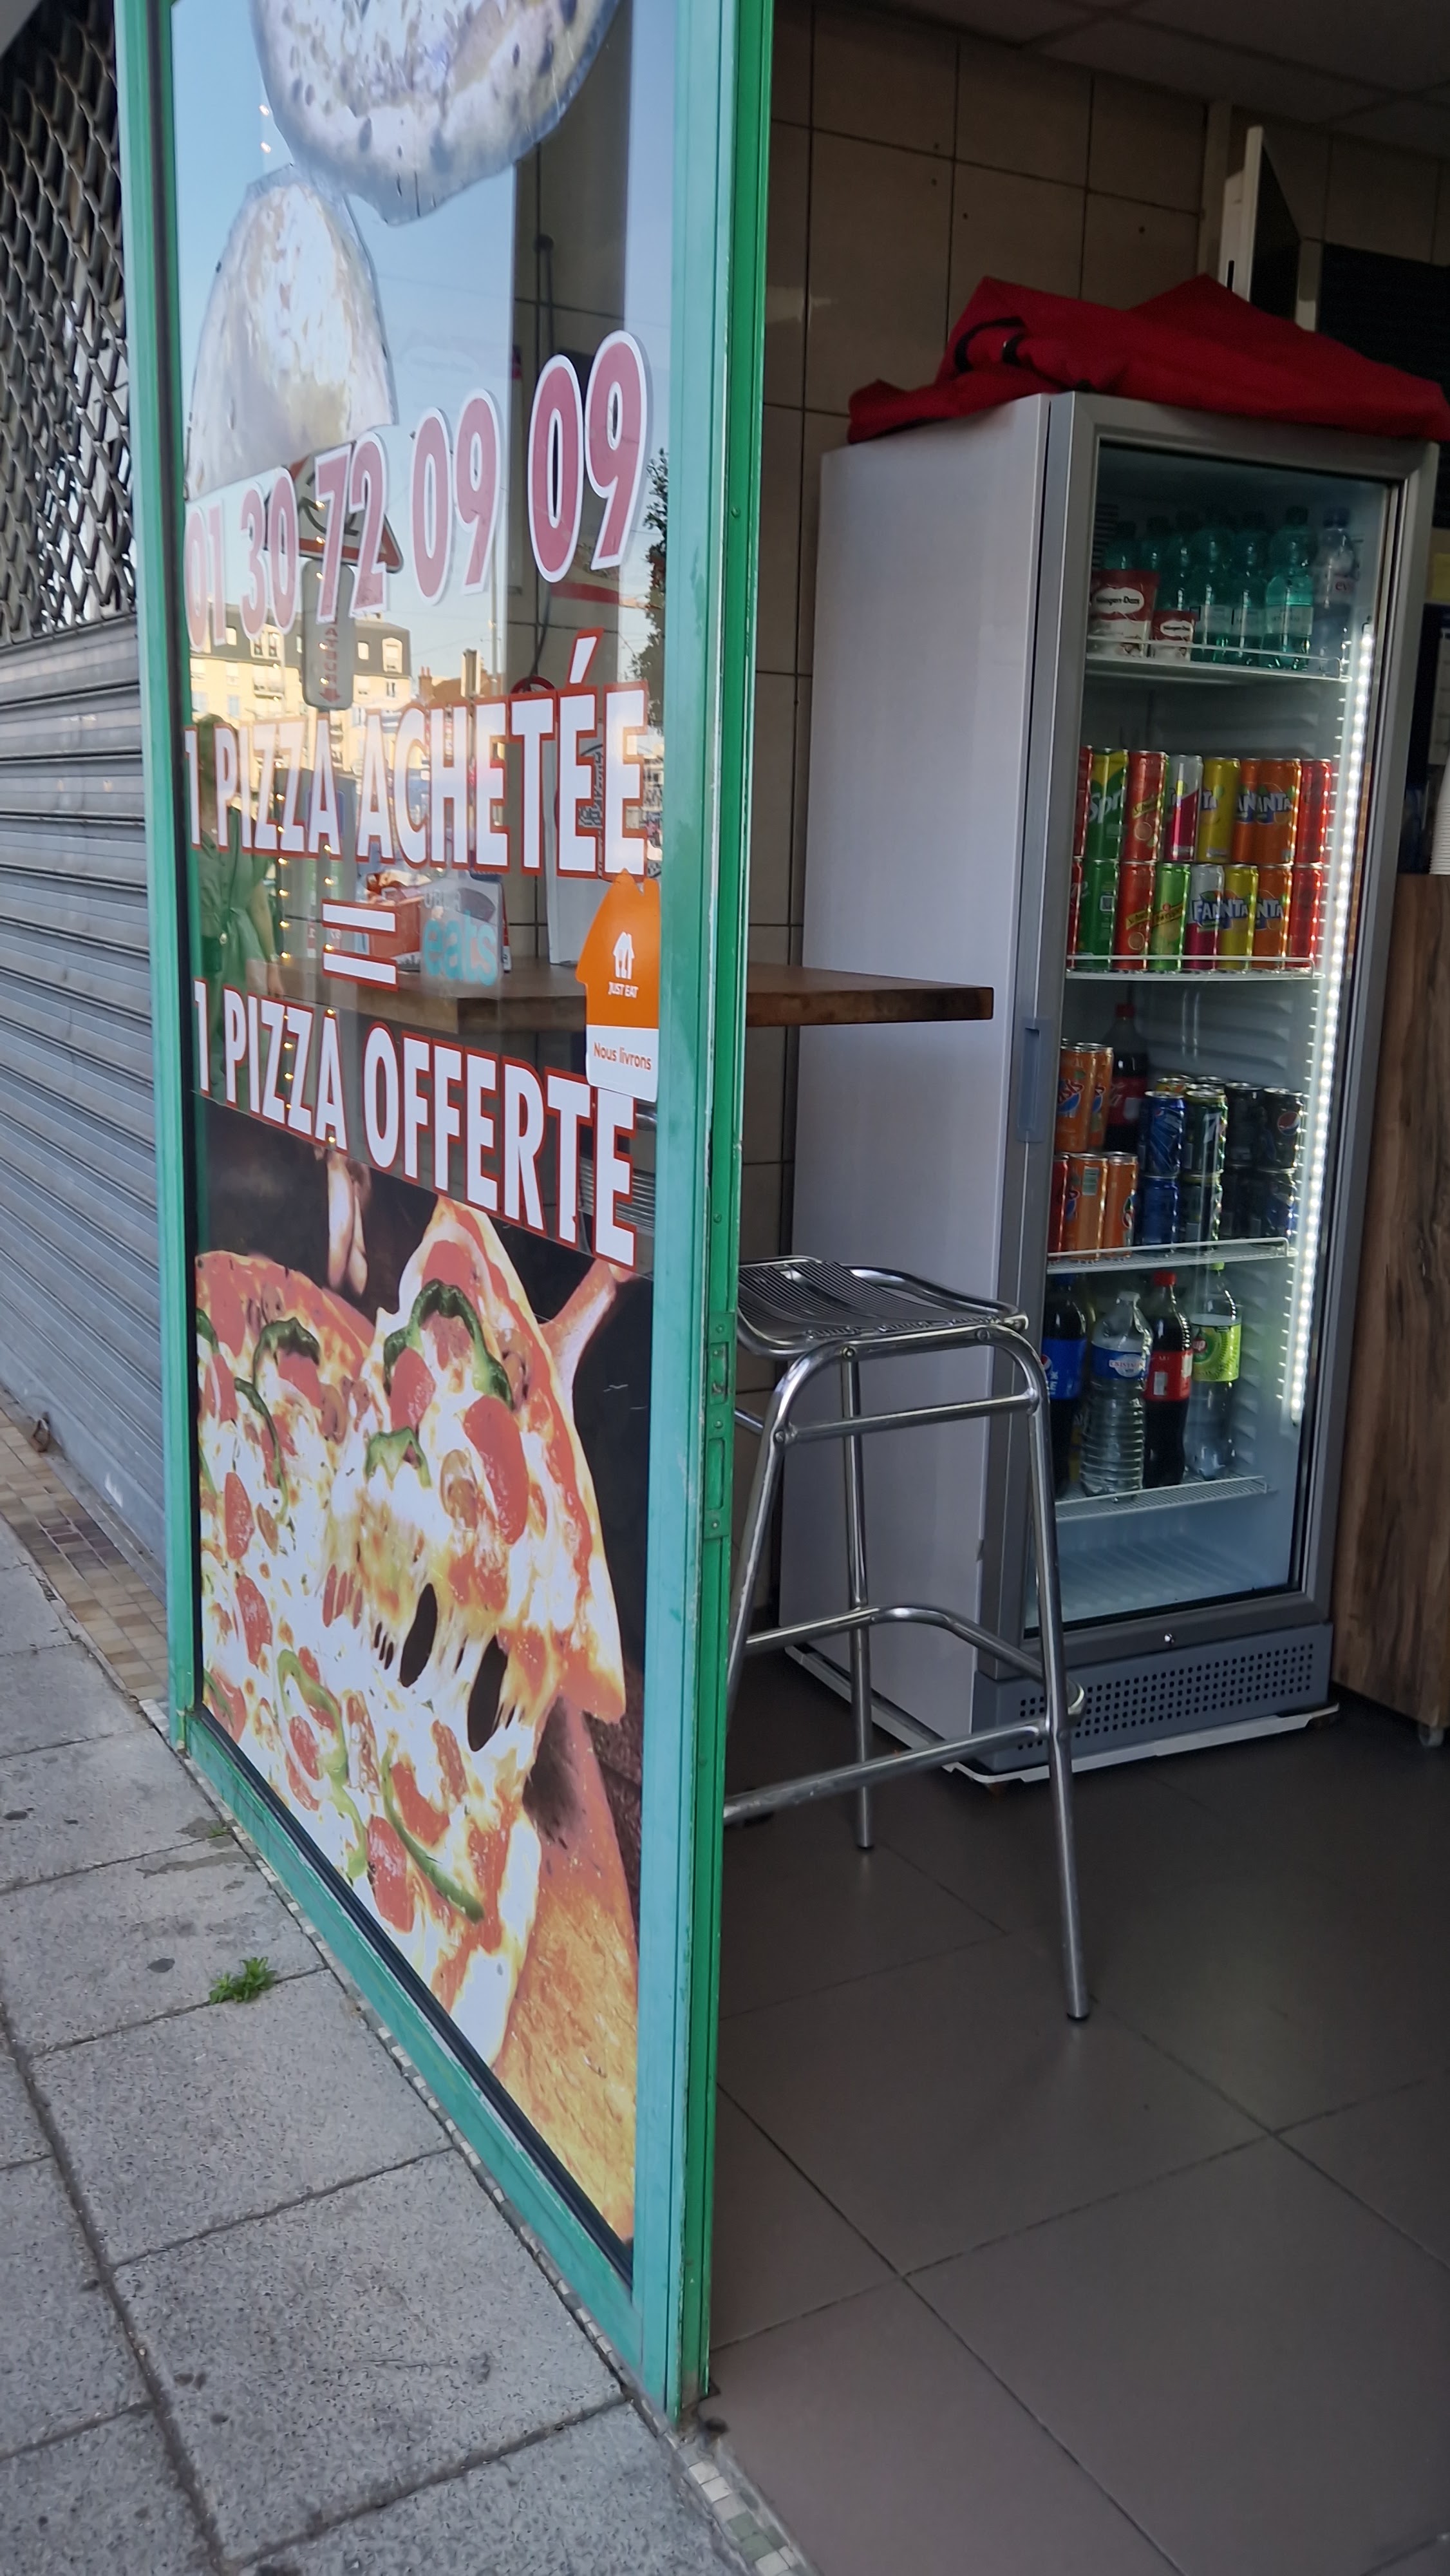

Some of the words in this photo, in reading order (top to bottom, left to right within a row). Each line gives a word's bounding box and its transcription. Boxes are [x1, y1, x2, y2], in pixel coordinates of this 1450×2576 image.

[184, 500, 228, 652] 01
[240, 468, 299, 641] 30
[314, 431, 388, 625] 72
[411, 388, 502, 605] 09
[527, 330, 647, 583] 09
[185, 725, 201, 850] 1
[214, 713, 342, 859] PIZZA
[356, 627, 648, 880] ACHETÉE
[422, 909, 498, 987] eats
[608, 981, 624, 996] JUST
[625, 985, 638, 998] EAT
[194, 978, 211, 1096] 1
[223, 985, 348, 1156] PIZZA
[363, 1021, 637, 1271] OFFERTE
[594, 1042, 617, 1062] Nous
[620, 1046, 651, 1070] livrons
